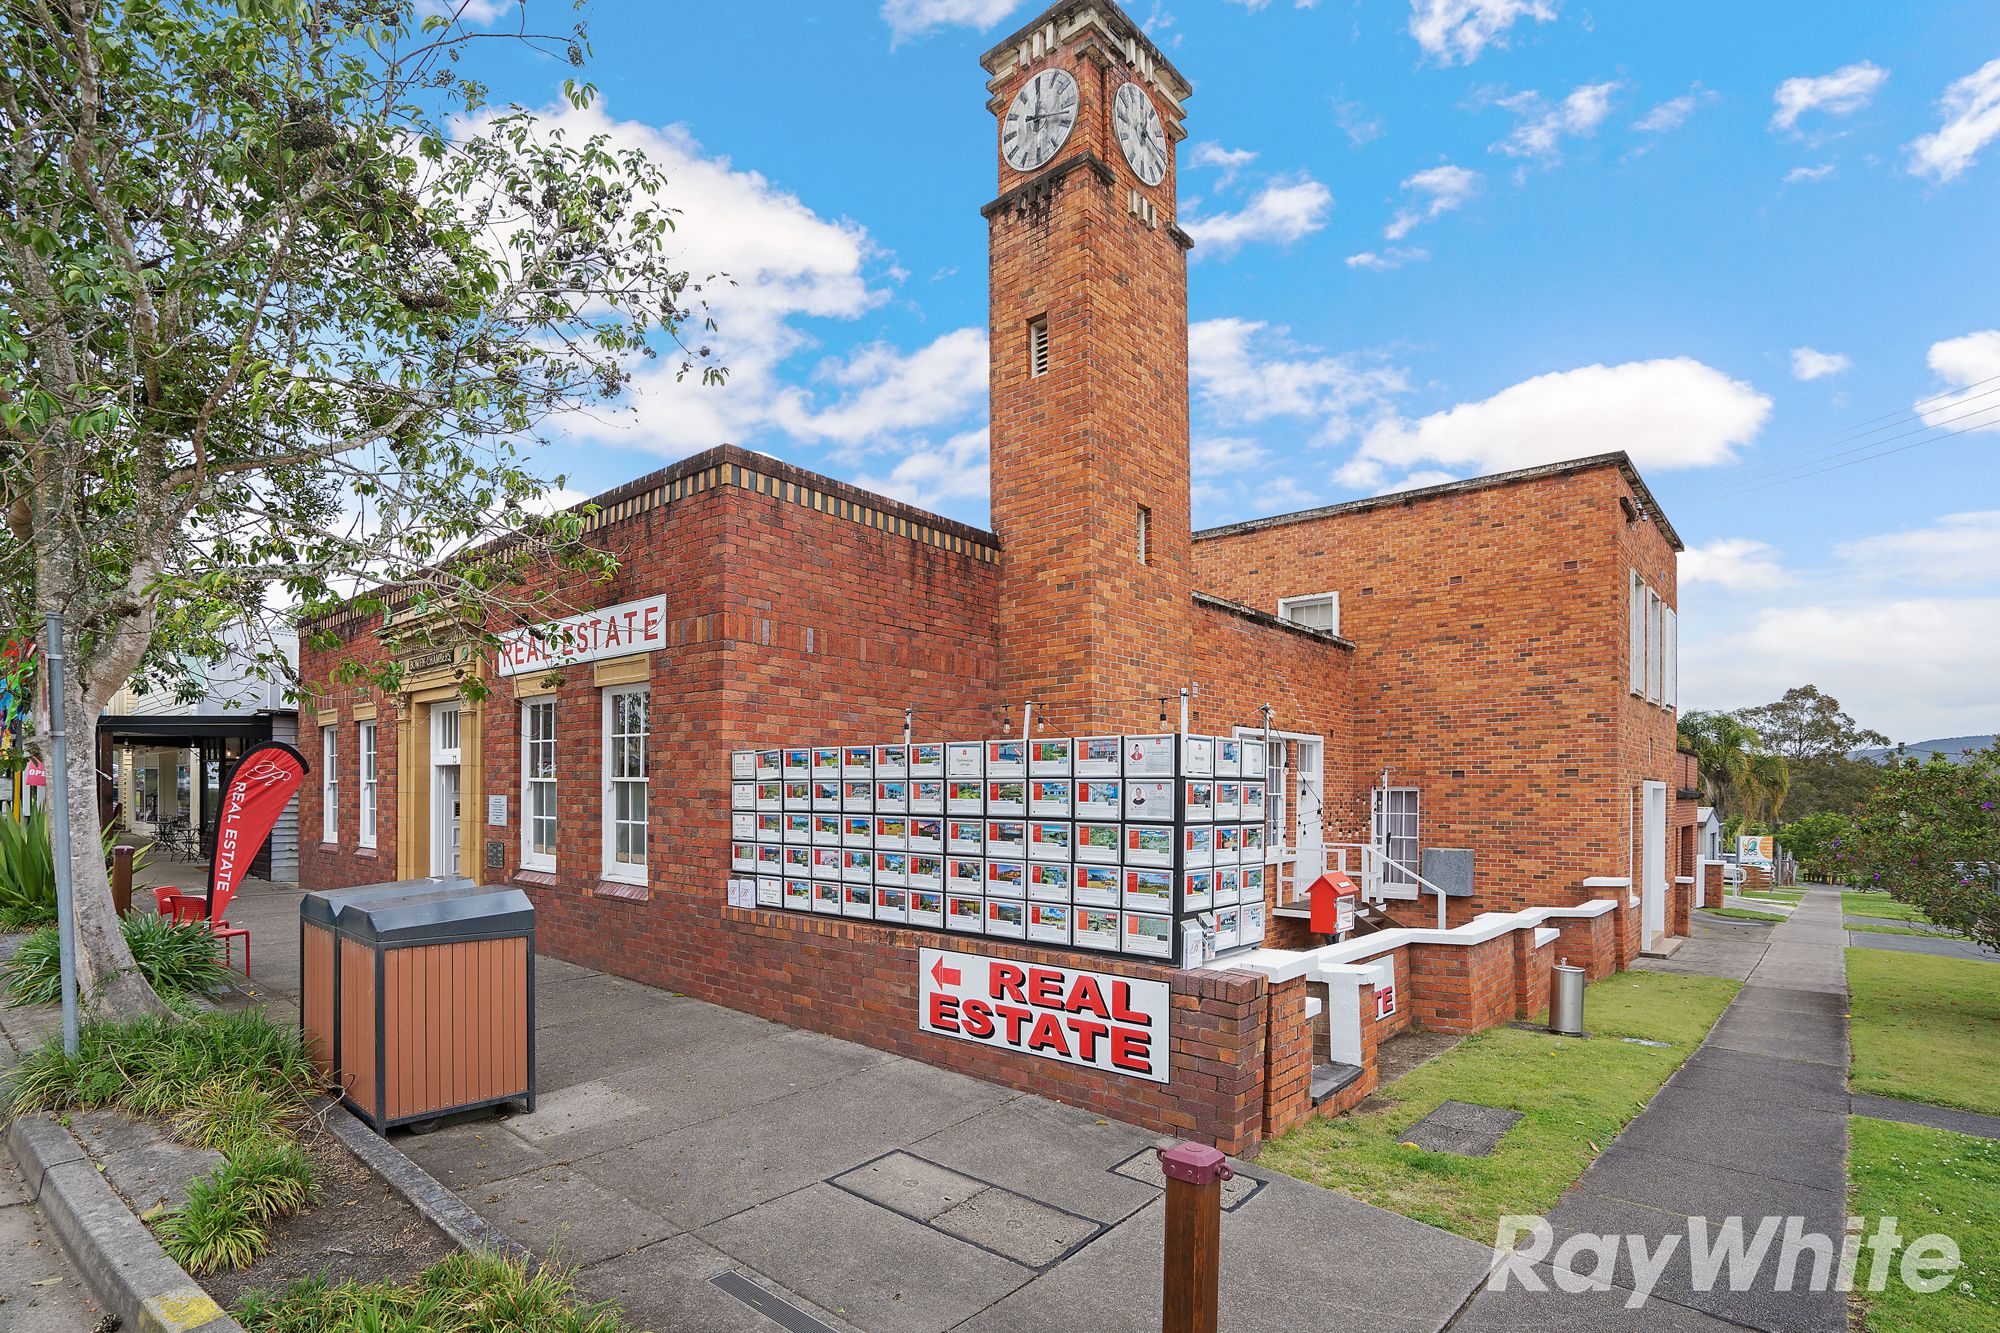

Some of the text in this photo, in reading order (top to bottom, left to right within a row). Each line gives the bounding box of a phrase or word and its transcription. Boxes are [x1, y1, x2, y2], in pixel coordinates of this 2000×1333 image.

[502, 606, 659, 668] REAL ESTATE
[216, 781, 247, 892] REAL ESTATE
[989, 961, 1152, 1027] REAL
[929, 991, 1152, 1075] ESTATE
